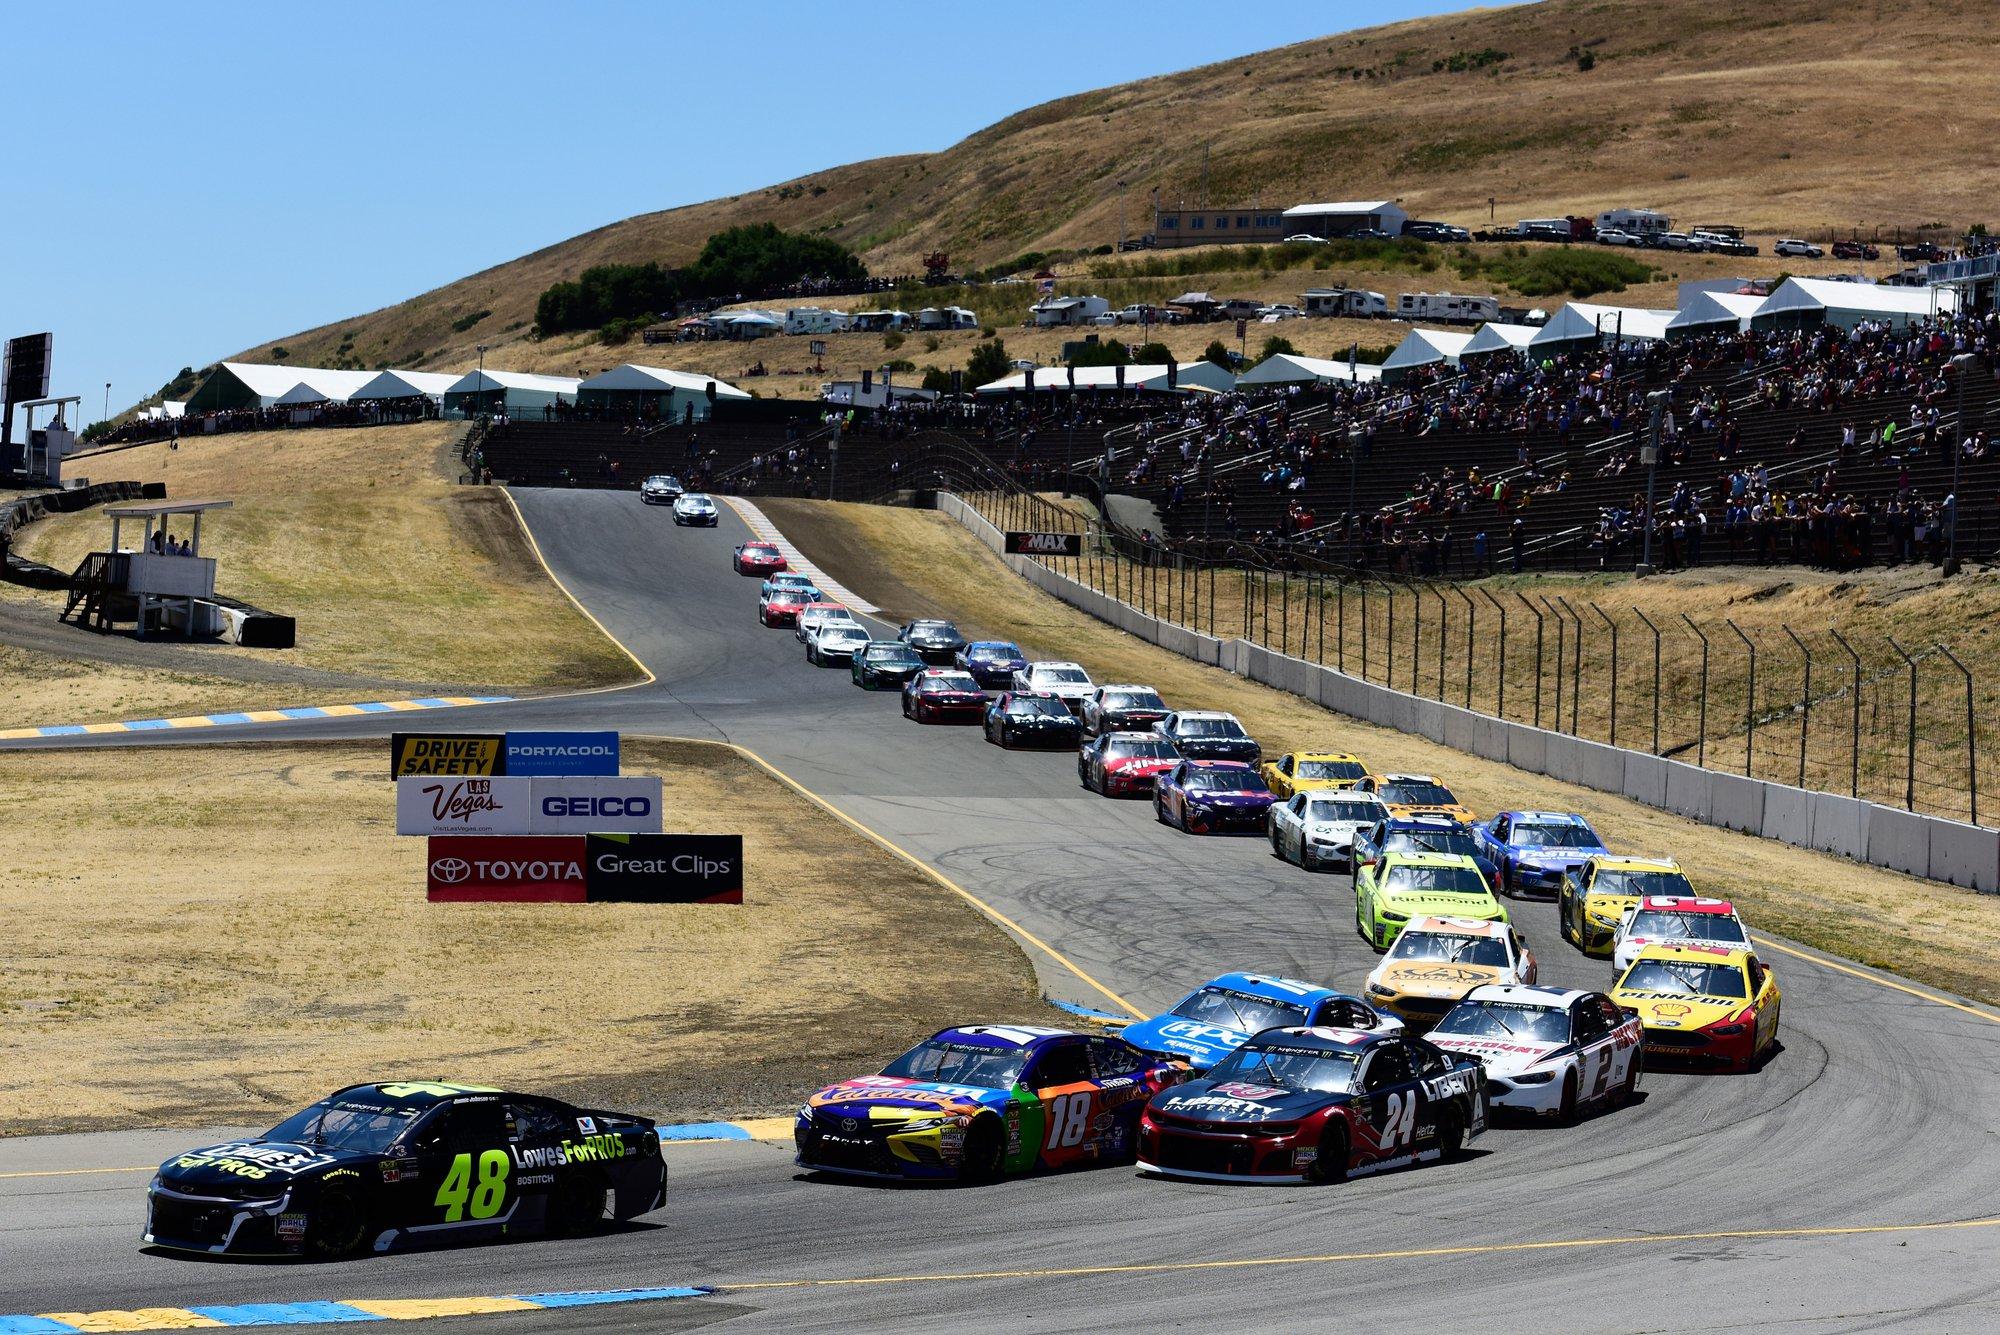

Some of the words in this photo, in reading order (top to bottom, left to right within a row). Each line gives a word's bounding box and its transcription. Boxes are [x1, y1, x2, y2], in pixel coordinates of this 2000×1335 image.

[414, 741, 480, 757] DRIVE
[508, 746, 614, 756] PORTACOOL
[403, 759, 488, 774] SAFETY
[469, 781, 489, 793] LAS
[422, 782, 503, 823] Vegas
[542, 796, 650, 817] GEICO
[474, 861, 583, 880] TOYOTA
[596, 854, 666, 875] Great
[672, 854, 730, 879] Clips
[1391, 895, 1488, 905] Richmond
[1234, 992, 1273, 1004] MONSTER
[1493, 1002, 1535, 1010] MONSTER
[1619, 991, 1736, 1007] PENNZOIL
[1167, 1023, 1249, 1047] PPG
[1277, 1047, 1320, 1055] MONSTER
[1430, 1039, 1548, 1055] DISCOUNT
[1592, 1043, 1613, 1098] 2
[1420, 1067, 1478, 1102] LIBERTY
[1162, 1105, 1270, 1121] UNIVERSITY
[1167, 1096, 1283, 1115] LIBERTY
[1047, 1092, 1092, 1150] 18
[1379, 1090, 1417, 1150] 24
[1416, 1125, 1436, 1138] Hertz
[207, 1158, 273, 1180] PROS
[322, 1168, 360, 1181] GOODYEAR
[434, 1149, 510, 1223] 48
[517, 1174, 554, 1186] BOSTITCH
